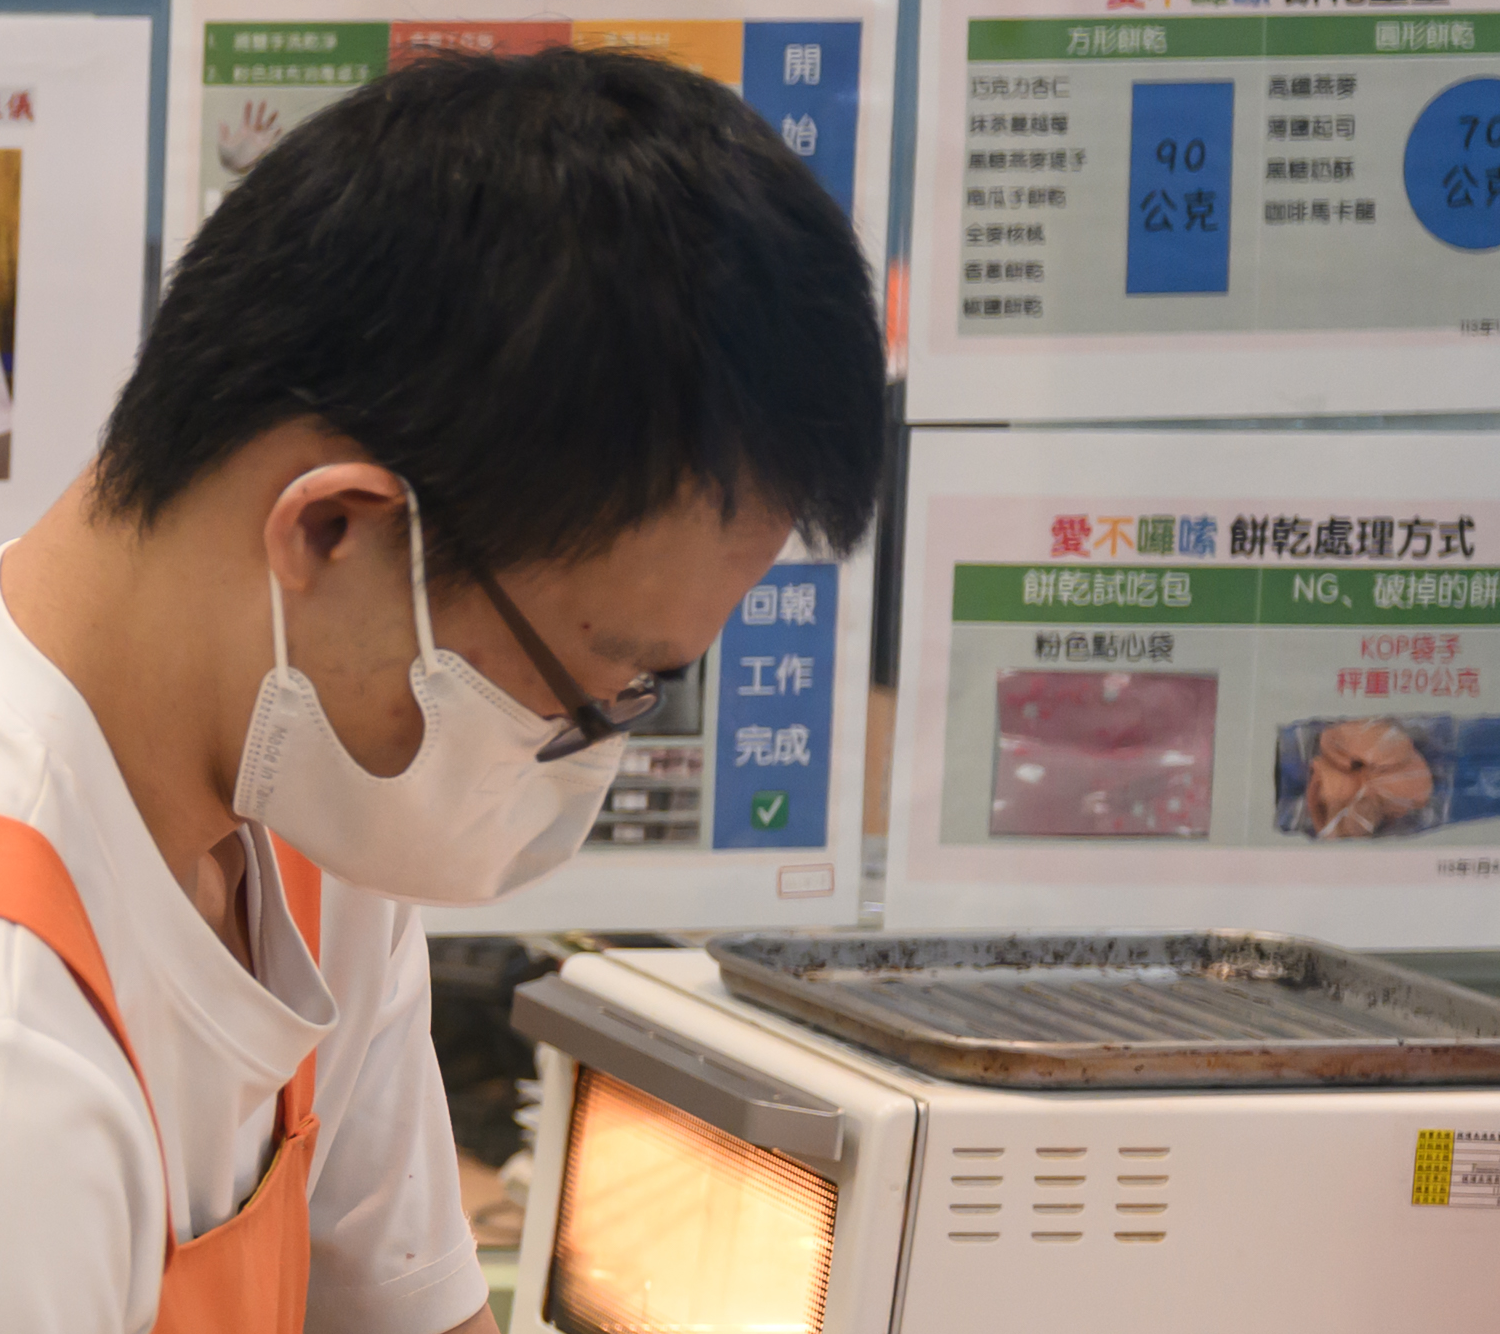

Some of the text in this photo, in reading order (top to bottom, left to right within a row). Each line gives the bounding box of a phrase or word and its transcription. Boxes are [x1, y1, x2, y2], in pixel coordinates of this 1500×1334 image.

[1066, 25, 1168, 56] 方形餅乾
[971, 75, 1071, 99] 巧克力杏仁
[1155, 137, 1207, 174] 90
[1139, 187, 1219, 234] 公克
[1050, 513, 1475, 558] 愛不囉嗦 餅乾處理方式
[741, 582, 818, 627] 回報
[1022, 569, 1192, 607] 餅乾試吃包
[1034, 630, 1175, 662] 粉色點心袋
[737, 655, 814, 696] 工作
[735, 725, 811, 767] 完成
